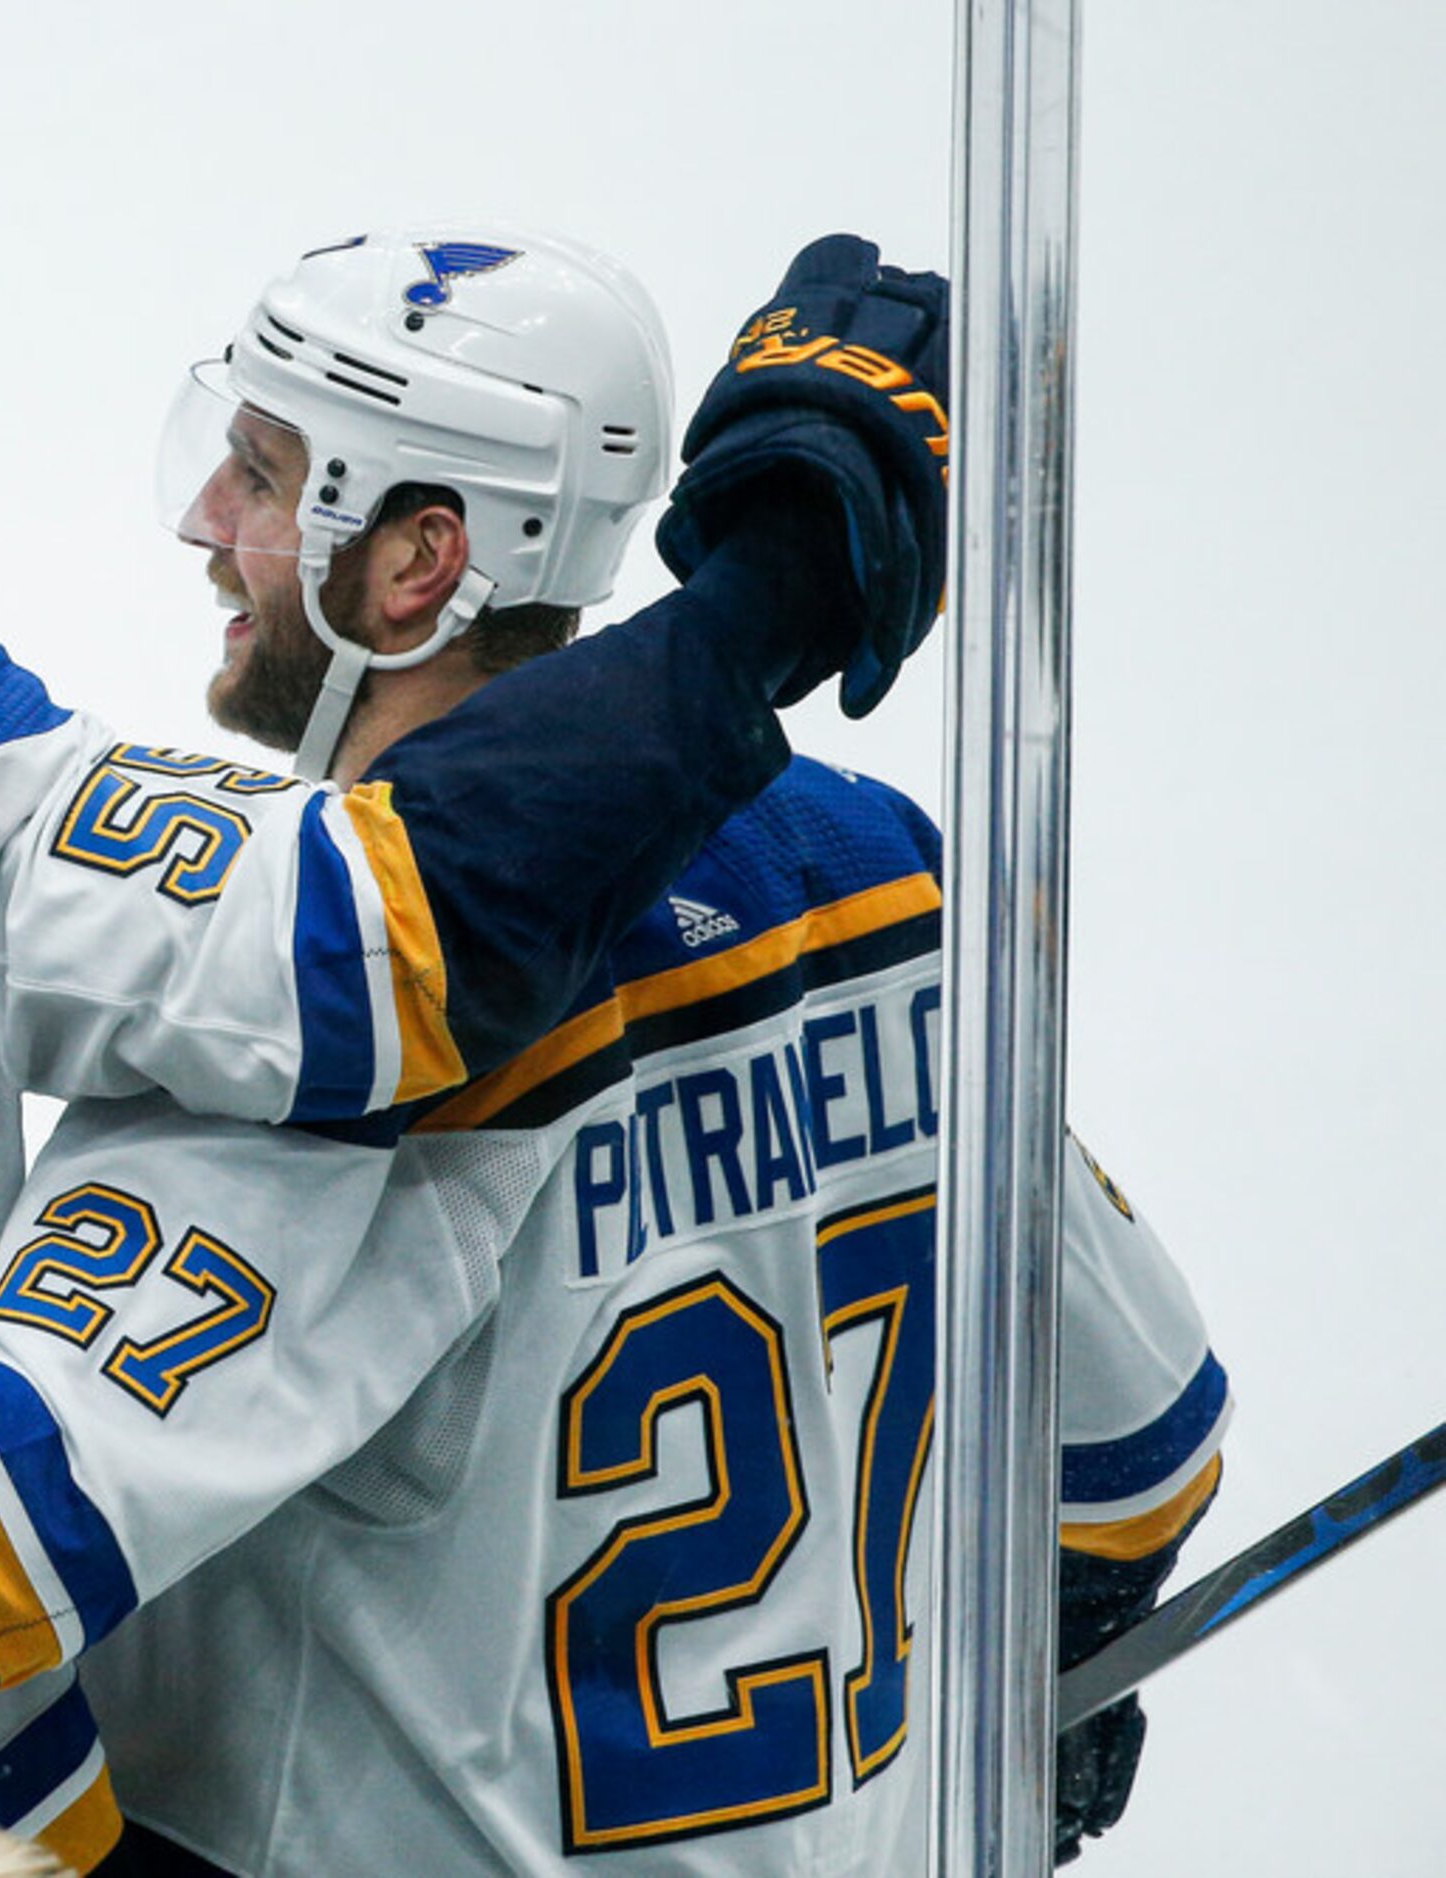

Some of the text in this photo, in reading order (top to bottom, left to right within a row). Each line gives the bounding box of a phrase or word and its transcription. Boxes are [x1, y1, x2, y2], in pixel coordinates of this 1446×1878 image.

[736, 335, 949, 489] UER
[682, 914, 741, 948] adidas
[544, 1183, 936, 1856] 27
